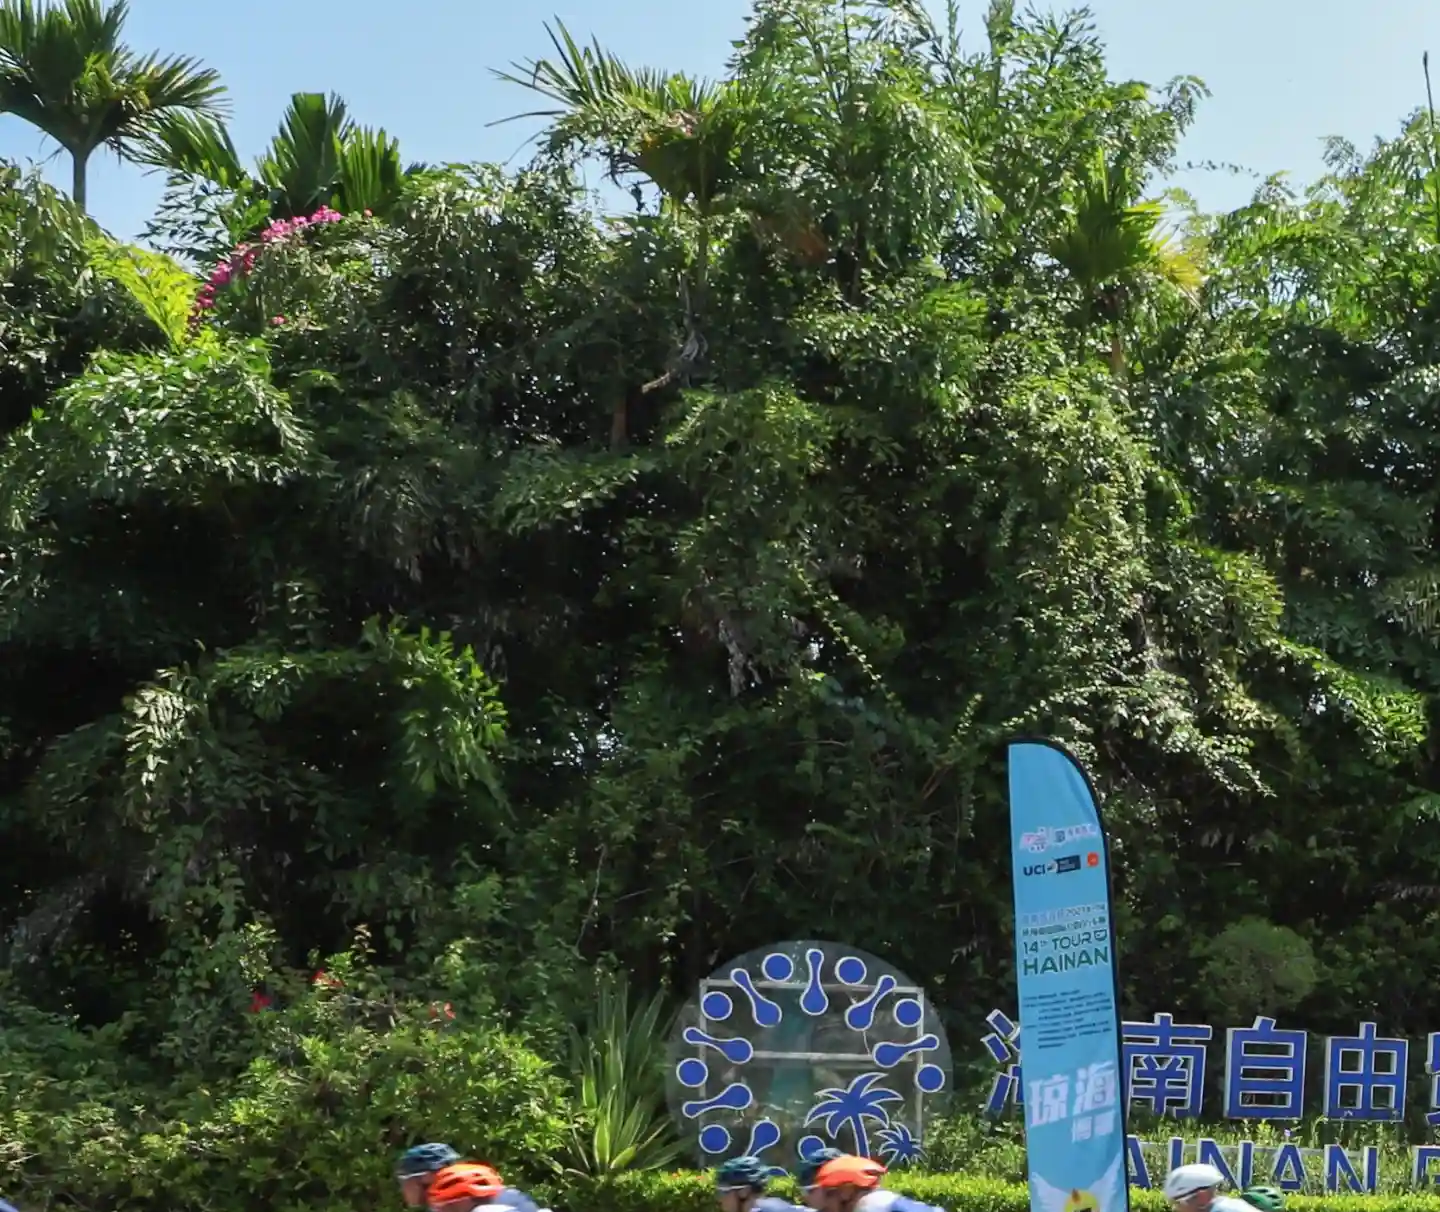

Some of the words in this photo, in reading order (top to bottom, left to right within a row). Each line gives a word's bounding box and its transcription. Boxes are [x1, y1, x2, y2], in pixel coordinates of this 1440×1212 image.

[1023, 863, 1046, 877] UCI
[1052, 931, 1091, 952] TOUR
[1023, 946, 1109, 976] HAINAN
[1127, 1134, 1379, 1195] AINAN
